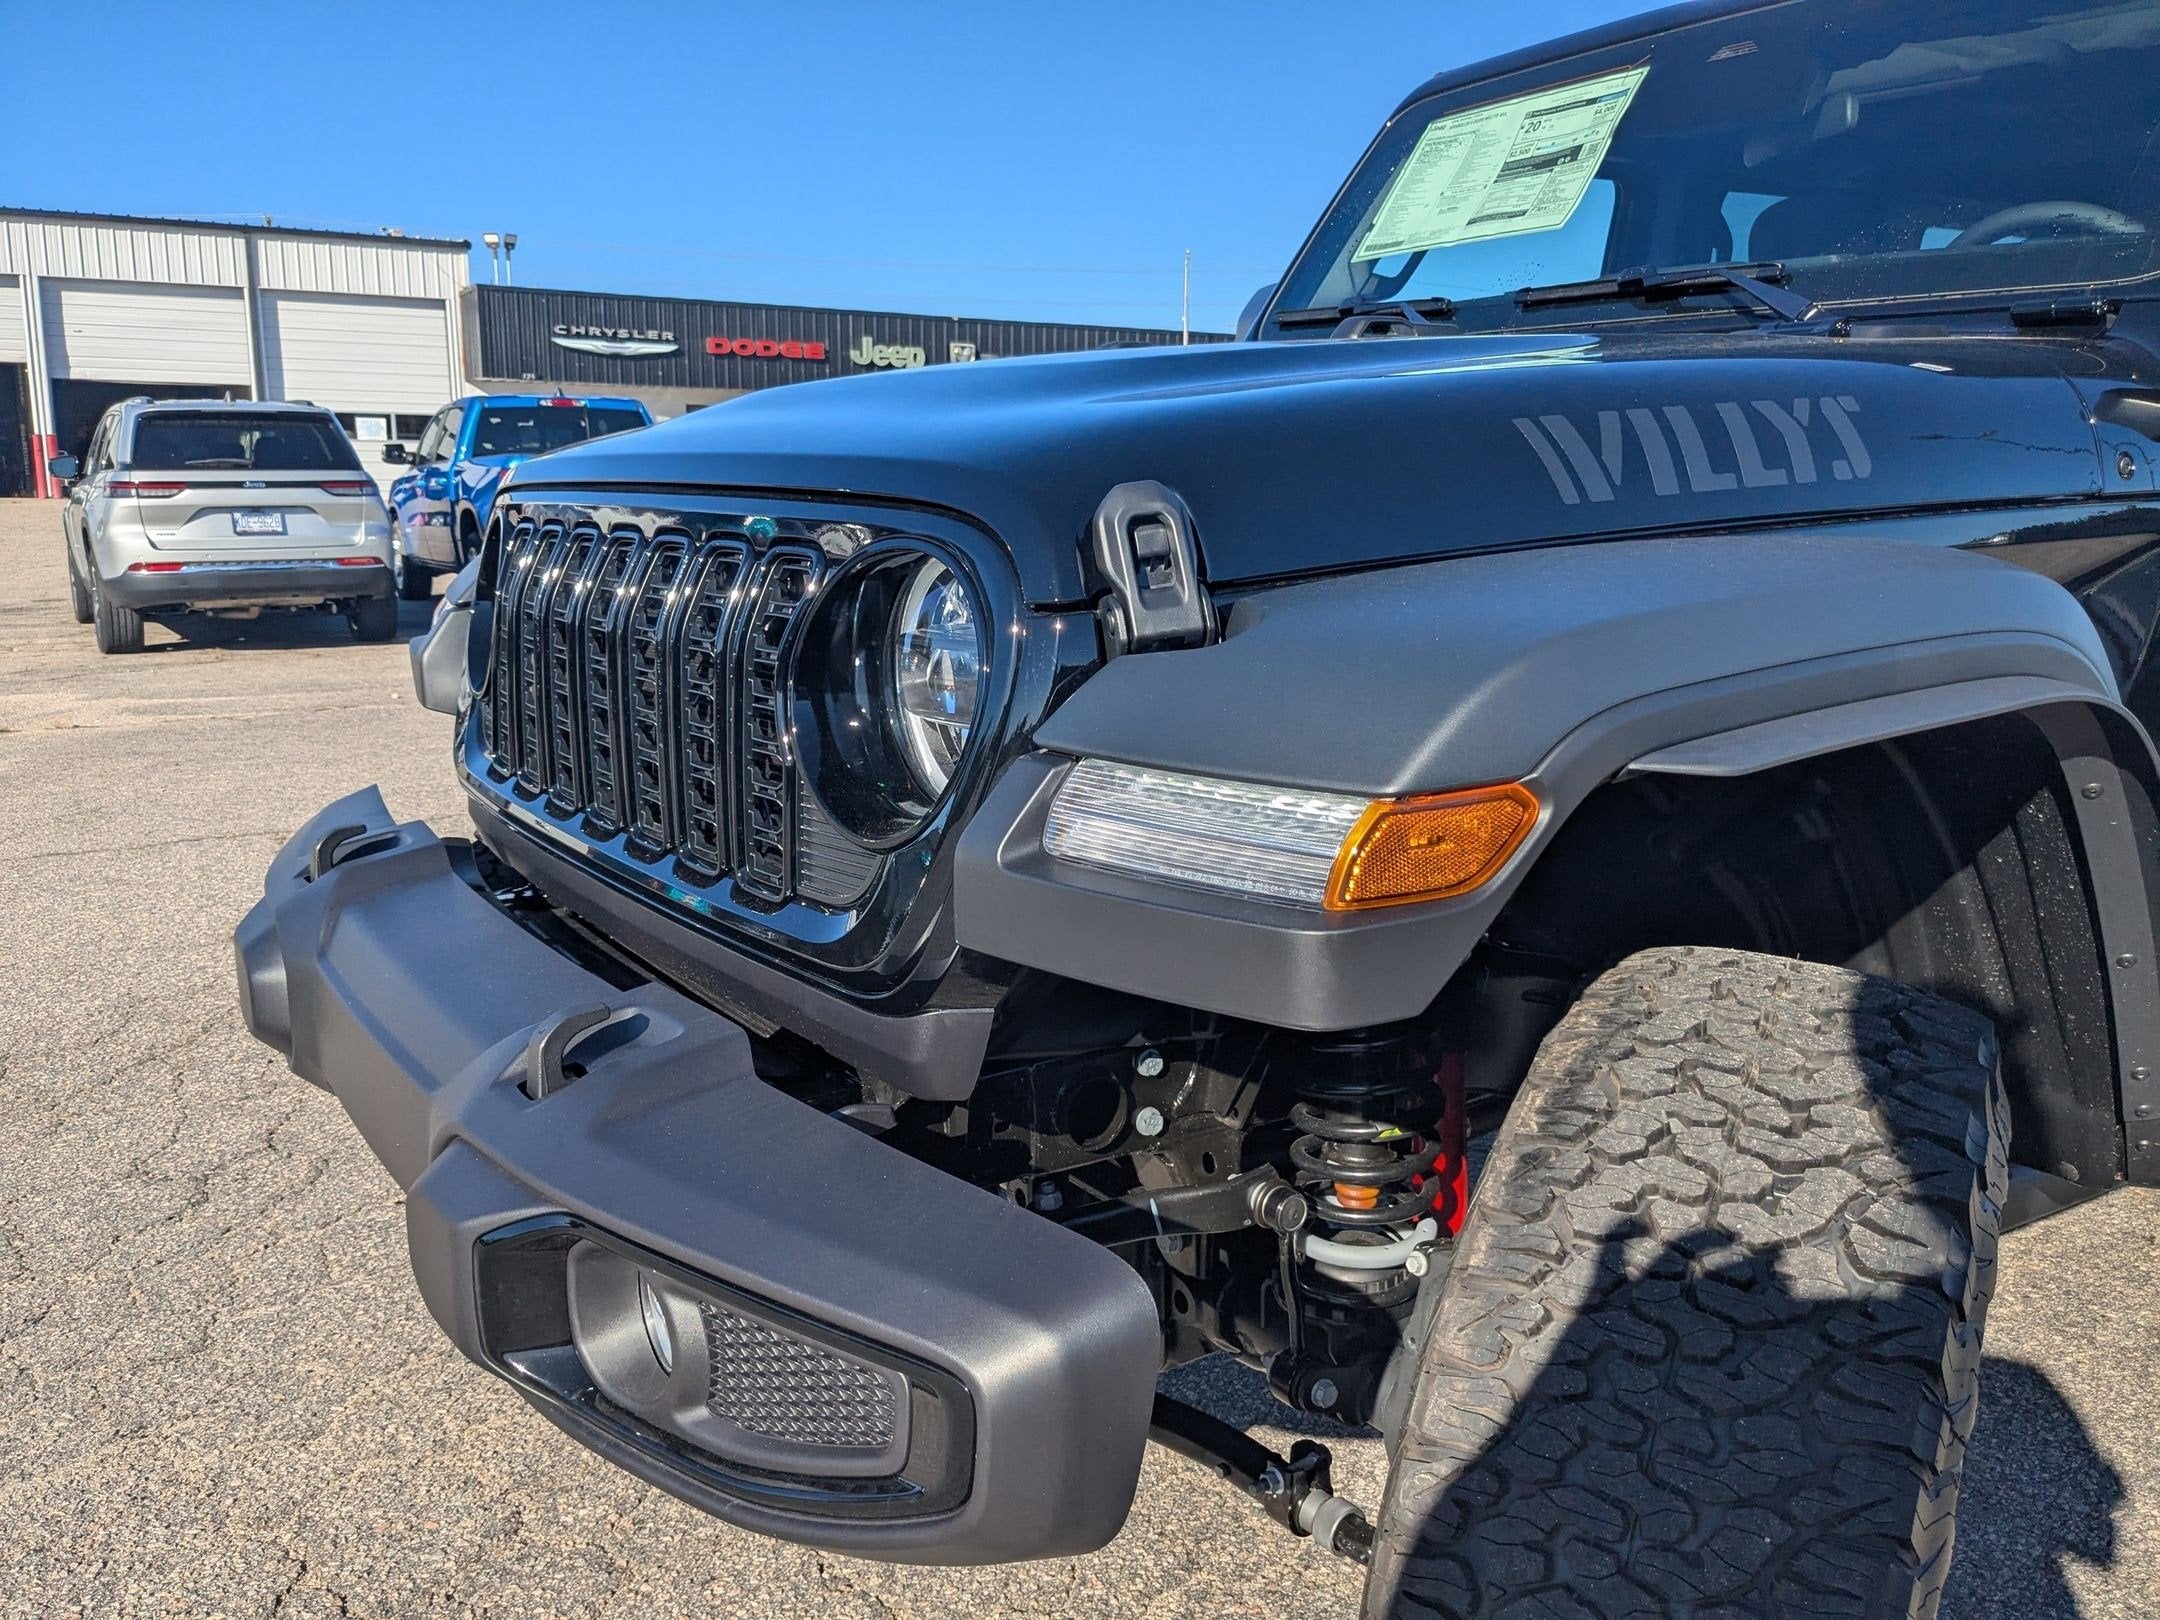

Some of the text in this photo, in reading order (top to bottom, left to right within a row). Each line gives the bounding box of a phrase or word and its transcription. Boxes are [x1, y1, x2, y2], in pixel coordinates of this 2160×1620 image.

[1524, 120, 1542, 134] 20
[552, 324, 676, 341] CHRYSLER
[705, 336, 826, 360] DODGE
[850, 336, 926, 369] Jeep
[1511, 395, 1873, 505] WILLYS
